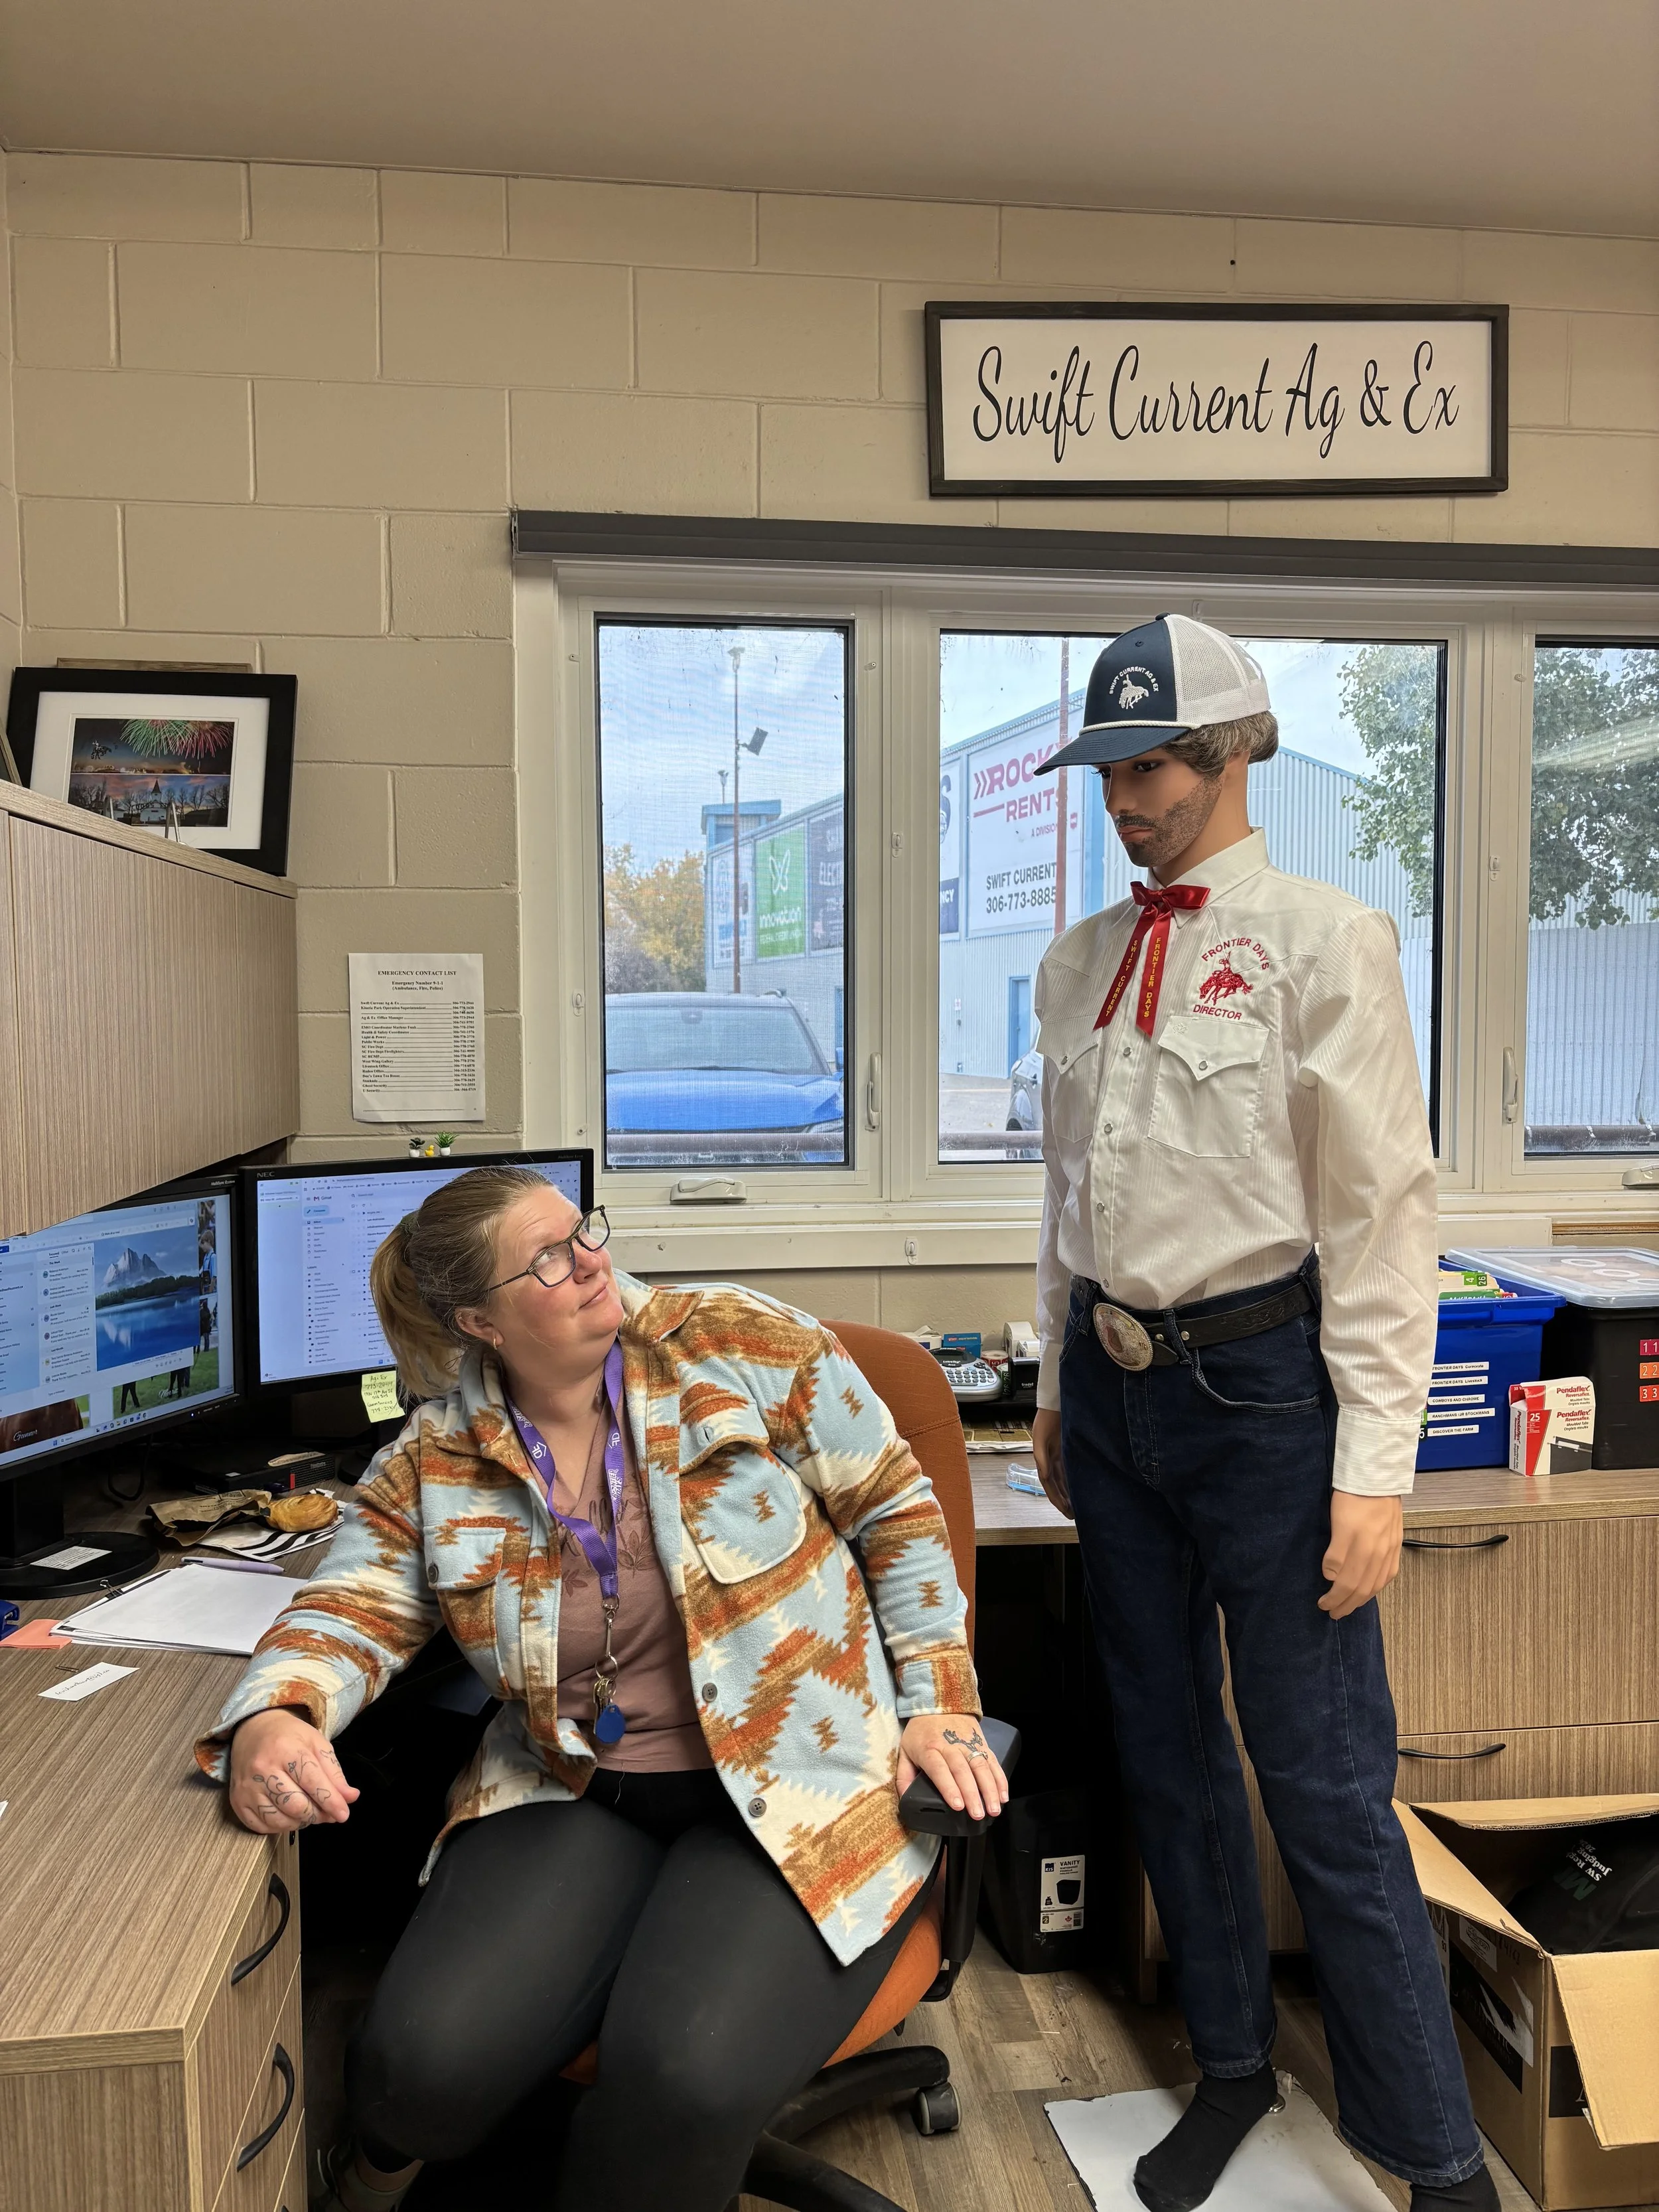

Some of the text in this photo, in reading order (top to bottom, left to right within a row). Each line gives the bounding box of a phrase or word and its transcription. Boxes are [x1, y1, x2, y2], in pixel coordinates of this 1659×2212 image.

[973, 340, 1459, 463] Swift Current Ag & Ex
[1109, 675, 1119, 695] SWIFT
[1119, 666, 1146, 677] CURRENT
[1153, 683, 1159, 692] EX
[1006, 787, 1058, 822] RENT
[1036, 822, 1058, 837] DIVISIO
[986, 862, 1056, 891] SWIFT CURRENT
[986, 886, 1056, 914] 306-773-8885
[1200, 937, 1270, 970] FRONTIER DAYS
[1105, 940, 1138, 1017] SWIFT CURRENT
[1143, 937, 1161, 1017] FRONTIER DAYS
[1192, 1004, 1242, 1021] DIRECTOR
[1478, 1276, 1486, 1286] 26
[1643, 1341, 1658, 1353] 1 1
[1642, 1364, 1658, 1376] 2 2
[1556, 1385, 1591, 1394] Pendaflex
[1642, 1388, 1657, 1399] 3 3
[1530, 1412, 1540, 1422] 25
[1556, 1409, 1592, 1418] Pendaflex
[1577, 1847, 1613, 1876] Judging
[1585, 1868, 1602, 1881] SW
